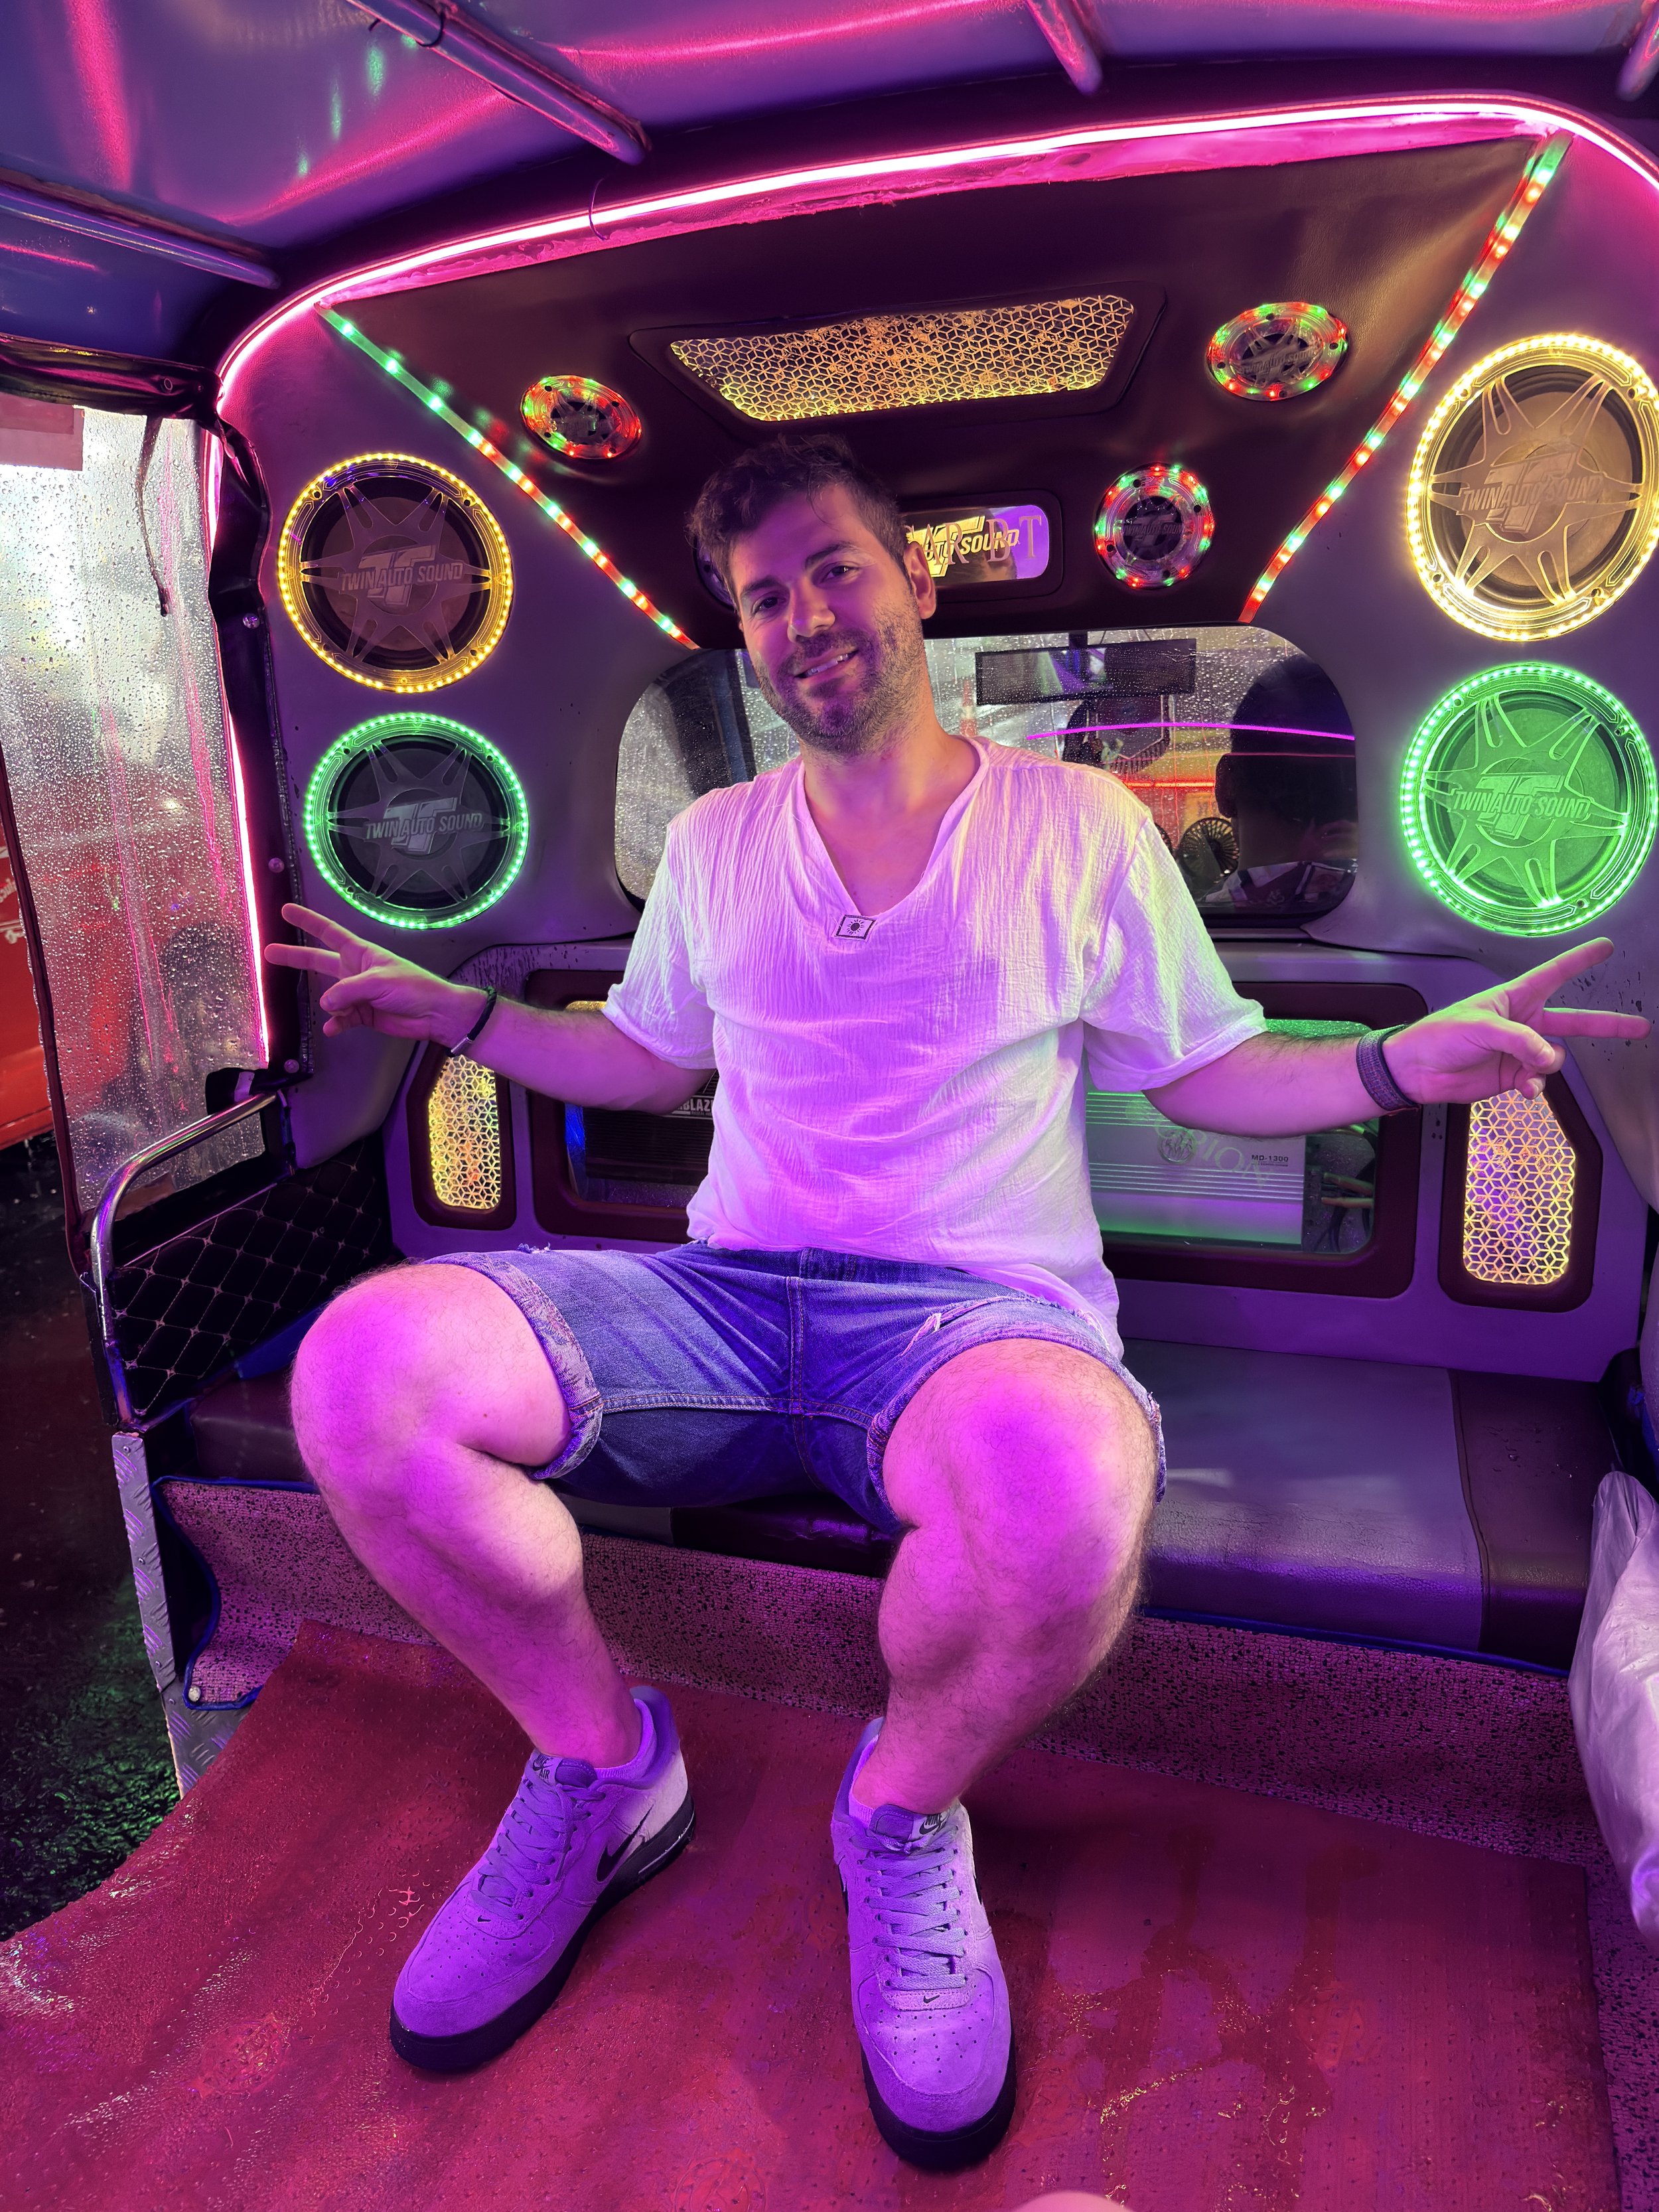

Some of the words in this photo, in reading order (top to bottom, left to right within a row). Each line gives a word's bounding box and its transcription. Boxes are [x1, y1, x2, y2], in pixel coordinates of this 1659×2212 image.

[1461, 487, 1501, 511] TWIN
[1498, 481, 1542, 508] AUTO
[342, 571, 376, 591] TWIN
[378, 567, 413, 589] AUTO
[417, 563, 463, 583] SOUND
[1453, 791, 1493, 812] TWIN
[1490, 793, 1532, 814] AUTO
[1534, 798, 1591, 819] SOUND
[366, 821, 398, 840] TWIN
[401, 817, 435, 838] AUTO
[439, 812, 483, 832] SOUND
[539, 1768, 550, 1779] AIR
